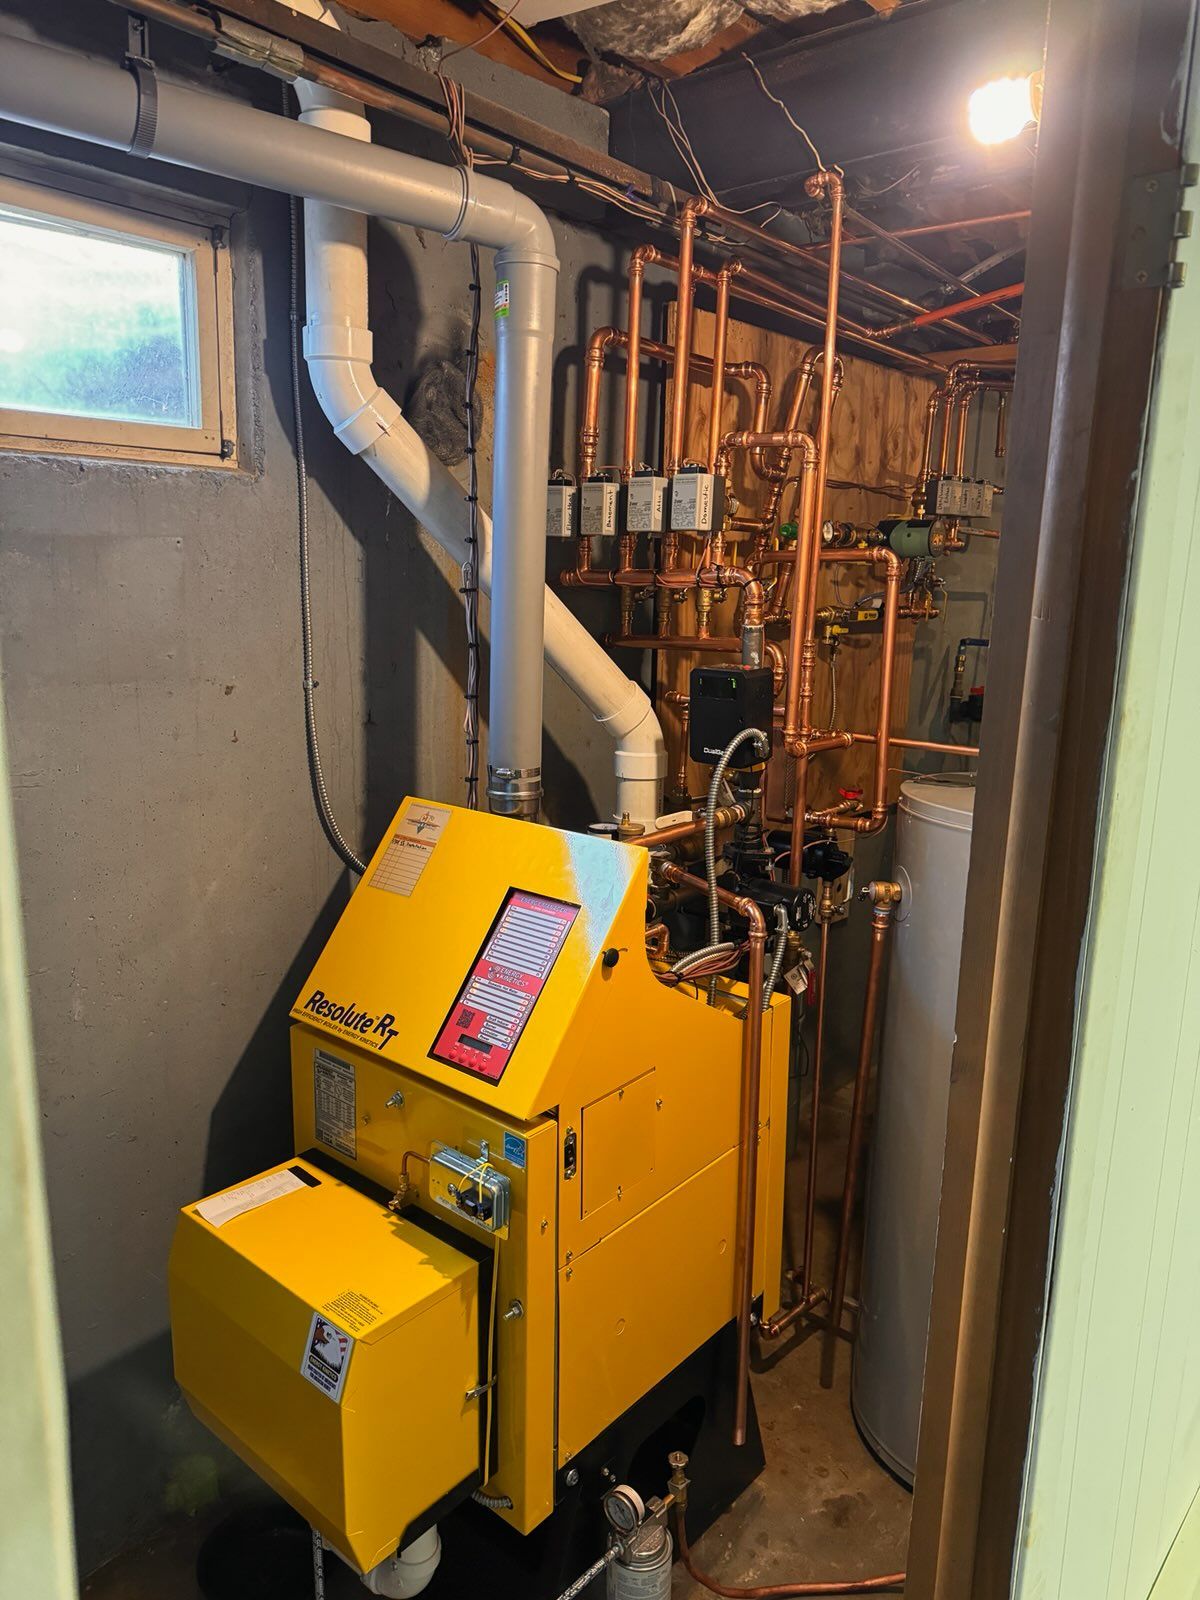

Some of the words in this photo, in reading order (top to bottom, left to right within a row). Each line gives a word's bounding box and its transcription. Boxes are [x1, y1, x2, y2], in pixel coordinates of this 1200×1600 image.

[701, 484, 710, 525] Domestic
[501, 967, 524, 979] ENERGY
[301, 1011, 324, 1026] EFFICIENCY
[323, 1020, 338, 1031] BOILER
[342, 1029, 360, 1041] ENERGY
[359, 1036, 379, 1049] KINETICS
